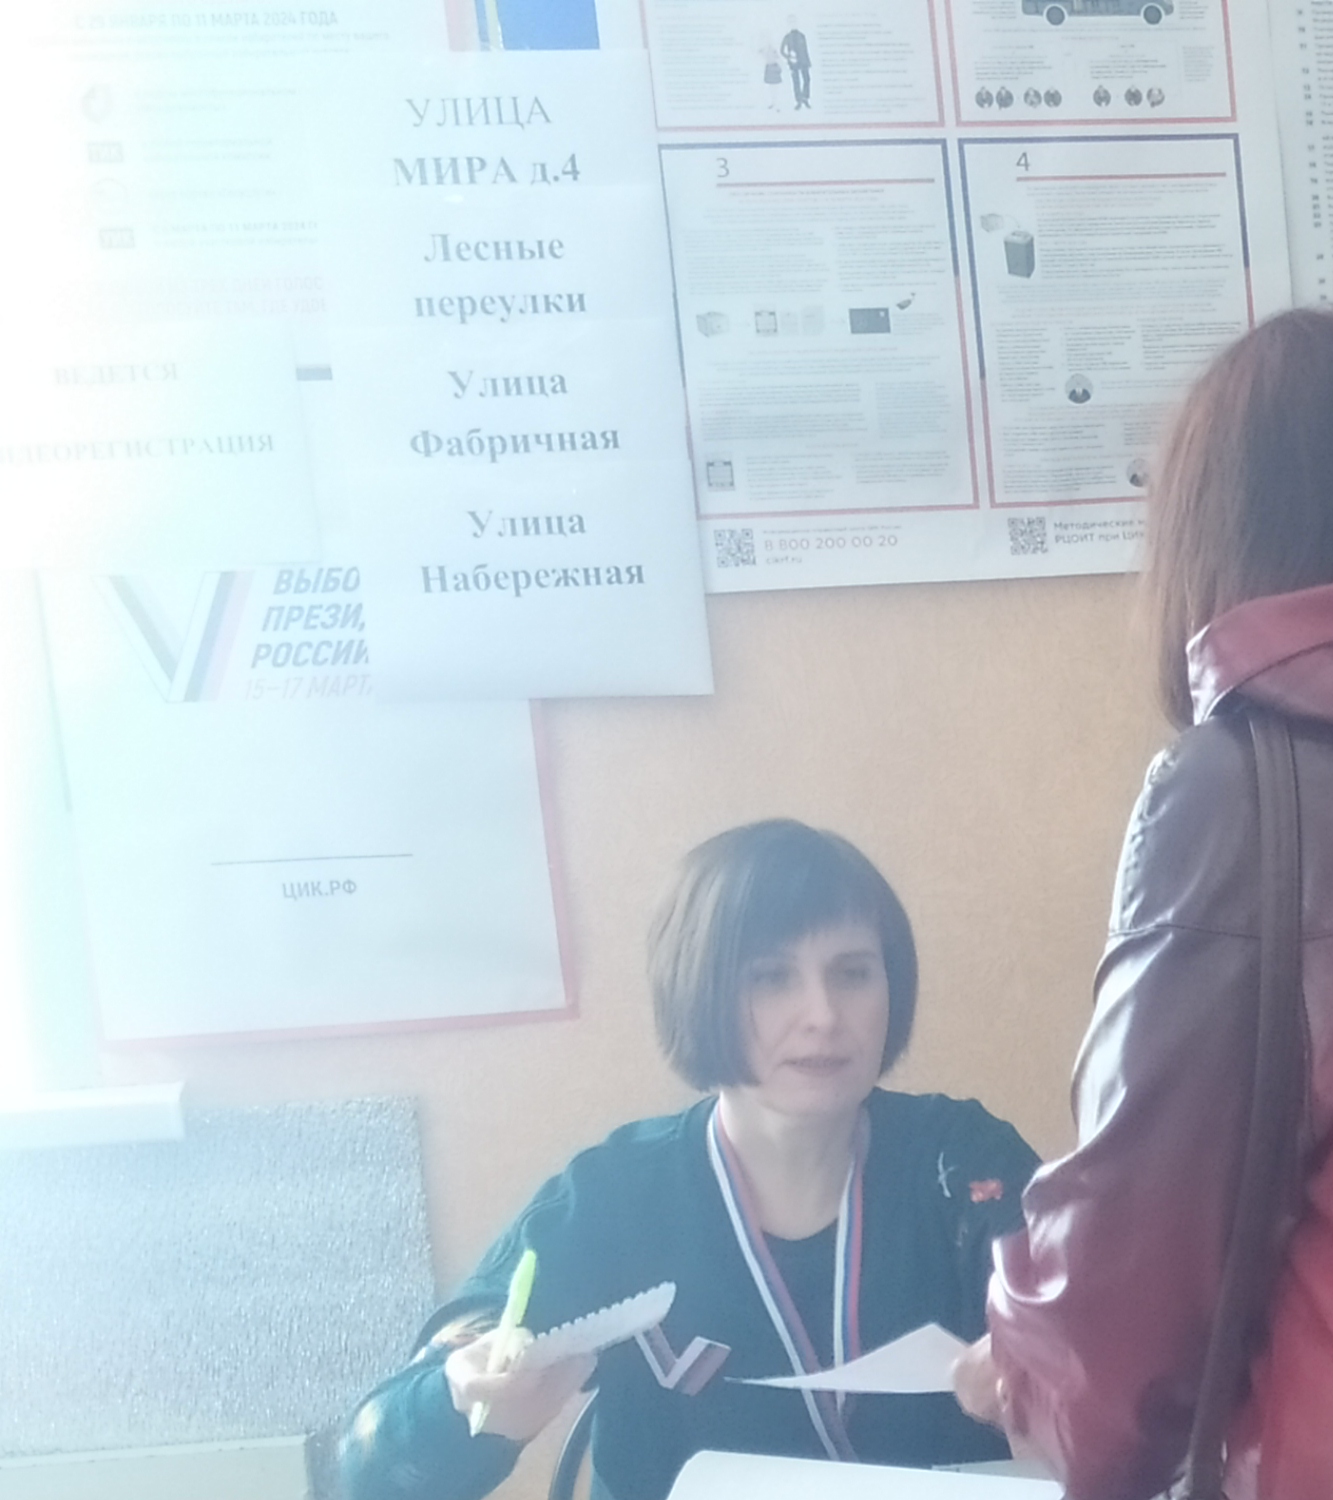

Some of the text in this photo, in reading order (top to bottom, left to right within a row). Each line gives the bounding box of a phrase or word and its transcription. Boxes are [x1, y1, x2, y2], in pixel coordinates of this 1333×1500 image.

[171, 13, 192, 27] ПО
[211, 12, 259, 27] МАРТА
[262, 11, 297, 26] 2024
[300, 10, 339, 26] ГОДА
[406, 95, 553, 132] УЛИЦА
[392, 152, 581, 187] МИРА д.4
[715, 157, 730, 178] 3
[1015, 151, 1031, 172] 4
[423, 233, 565, 264] Лесные
[413, 290, 588, 325] переулки
[53, 362, 179, 387] ВЕДЕТСЯ
[446, 368, 568, 400] Улица
[409, 428, 621, 463] Фабричная
[467, 509, 587, 539] Улица
[1053, 520, 1136, 531] Методические
[1055, 533, 1095, 545] РЦОИТ
[1099, 533, 1120, 542] при
[779, 538, 810, 551] 800
[815, 537, 847, 549] 200
[851, 536, 873, 548] 00
[878, 535, 898, 547] 20
[421, 563, 645, 599] Набережная
[261, 602, 366, 632] ПРЕЗИ
[281, 877, 358, 901] ЦИК.РФ
